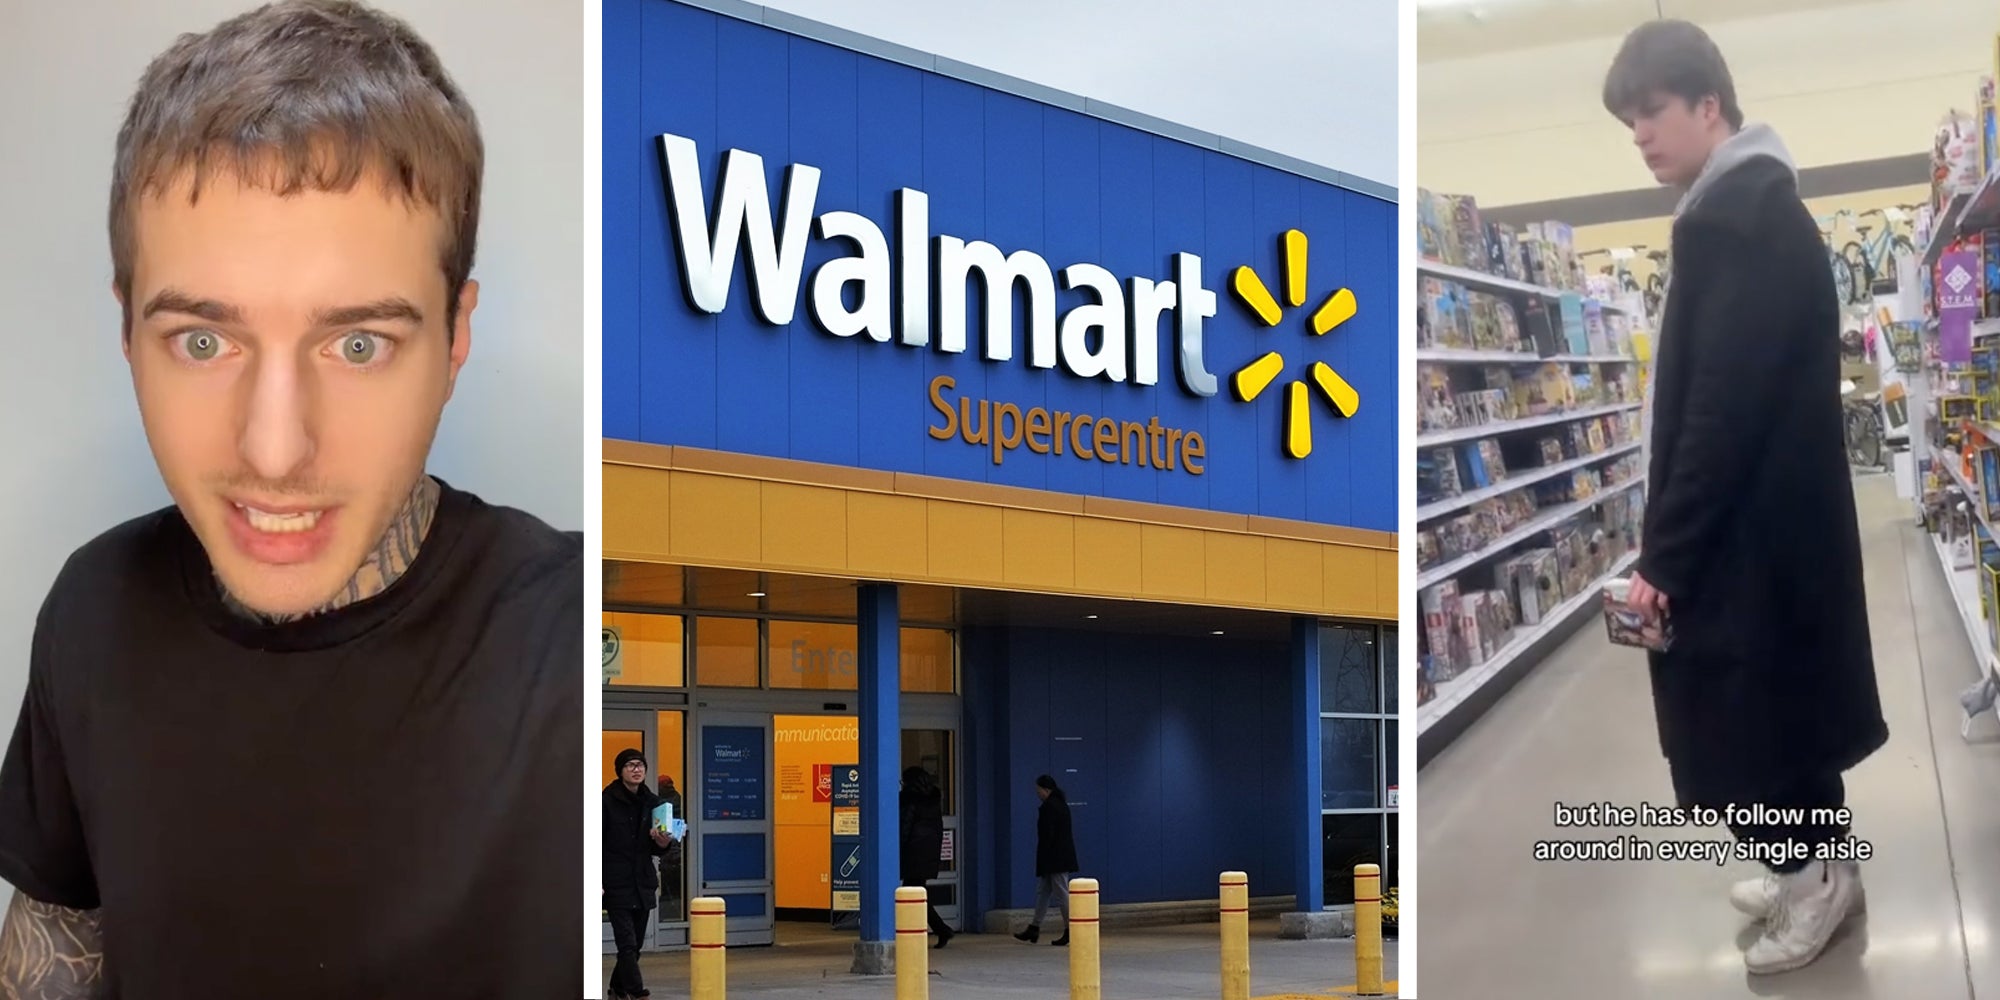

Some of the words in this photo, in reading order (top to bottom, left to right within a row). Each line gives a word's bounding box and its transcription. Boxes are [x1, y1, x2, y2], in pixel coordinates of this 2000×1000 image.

[657, 132, 1218, 398] Walmart
[929, 376, 1206, 476] Supercentre
[715, 749, 742, 758] Walmart
